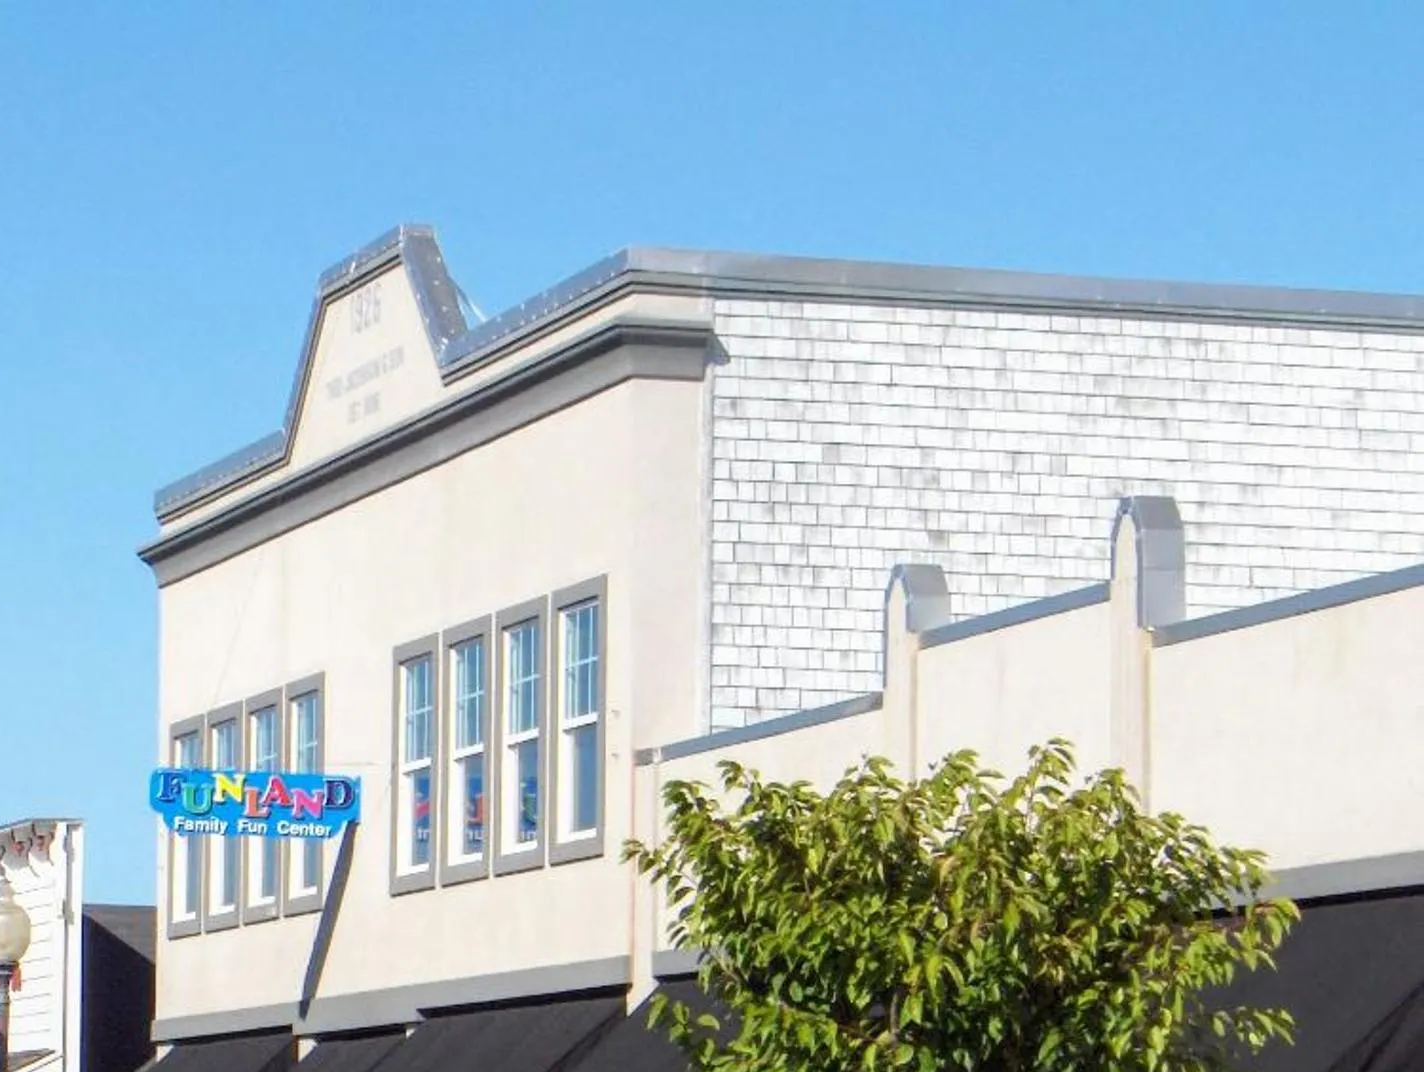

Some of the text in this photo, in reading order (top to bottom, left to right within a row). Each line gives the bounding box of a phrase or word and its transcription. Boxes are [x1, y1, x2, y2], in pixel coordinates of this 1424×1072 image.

[156, 770, 354, 819] FUNLAND
[173, 816, 332, 837] Family Fun Center
